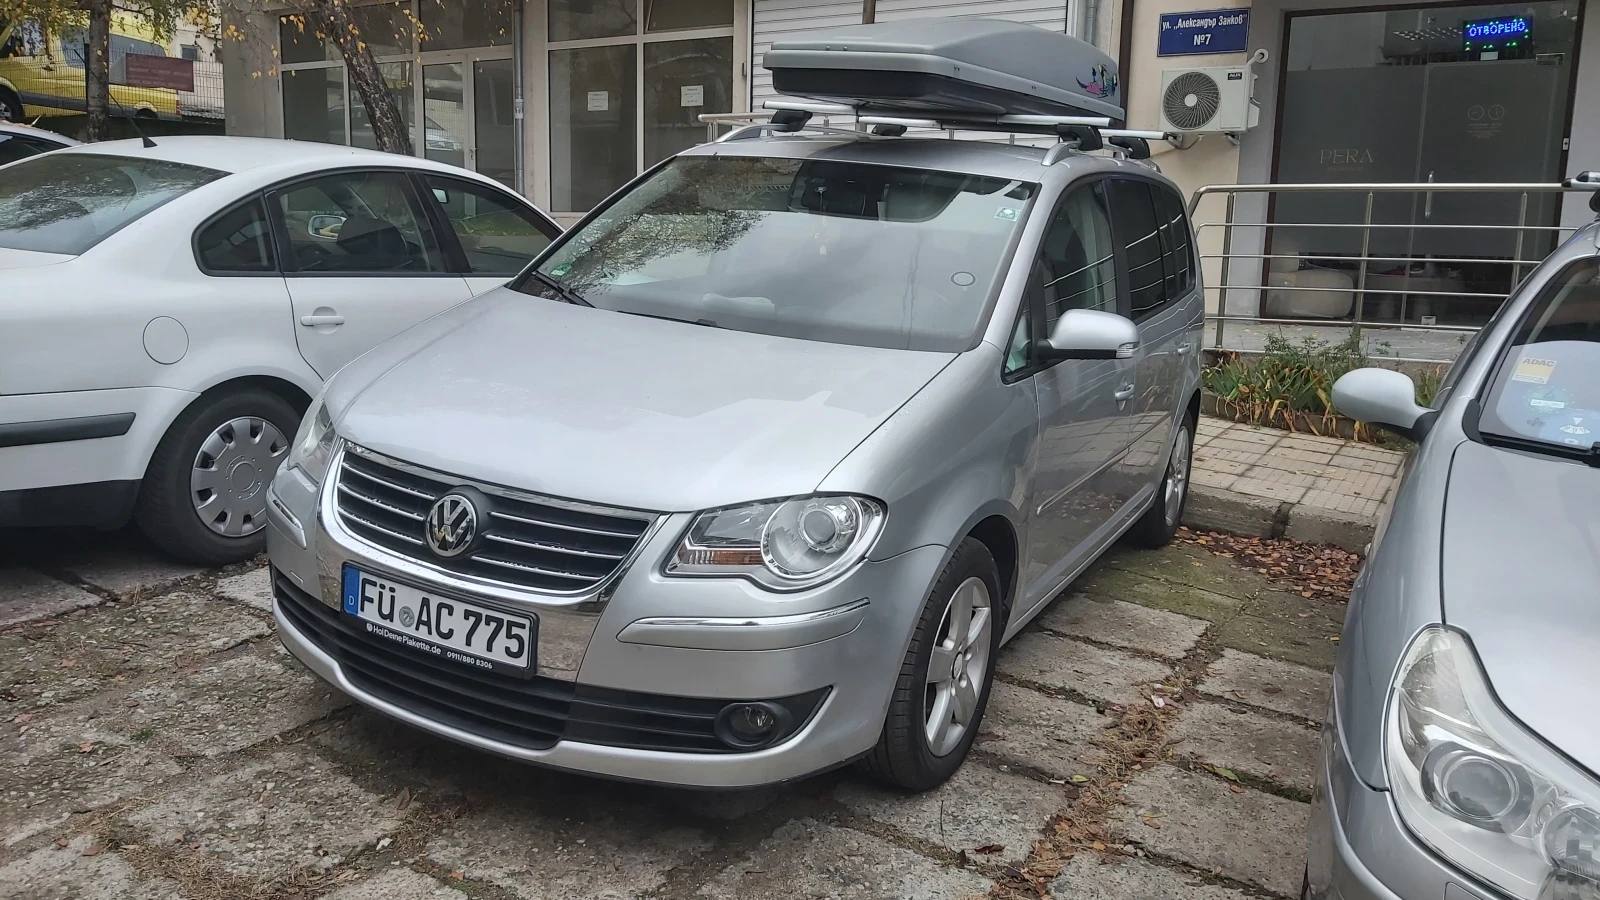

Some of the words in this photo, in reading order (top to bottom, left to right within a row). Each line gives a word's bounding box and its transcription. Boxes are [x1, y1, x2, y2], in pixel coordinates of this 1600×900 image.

[1162, 21, 1172, 31] ул.
[1469, 21, 1526, 37] ОТВОРЕНО
[1320, 148, 1374, 164] PERA
[1522, 358, 1555, 367] ADAC
[348, 595, 355, 606] D
[359, 577, 396, 623] FÜ
[415, 596, 455, 640] AC
[463, 608, 526, 659] 775
[446, 651, 475, 665] 0911/880
[476, 658, 493, 670] 8306
